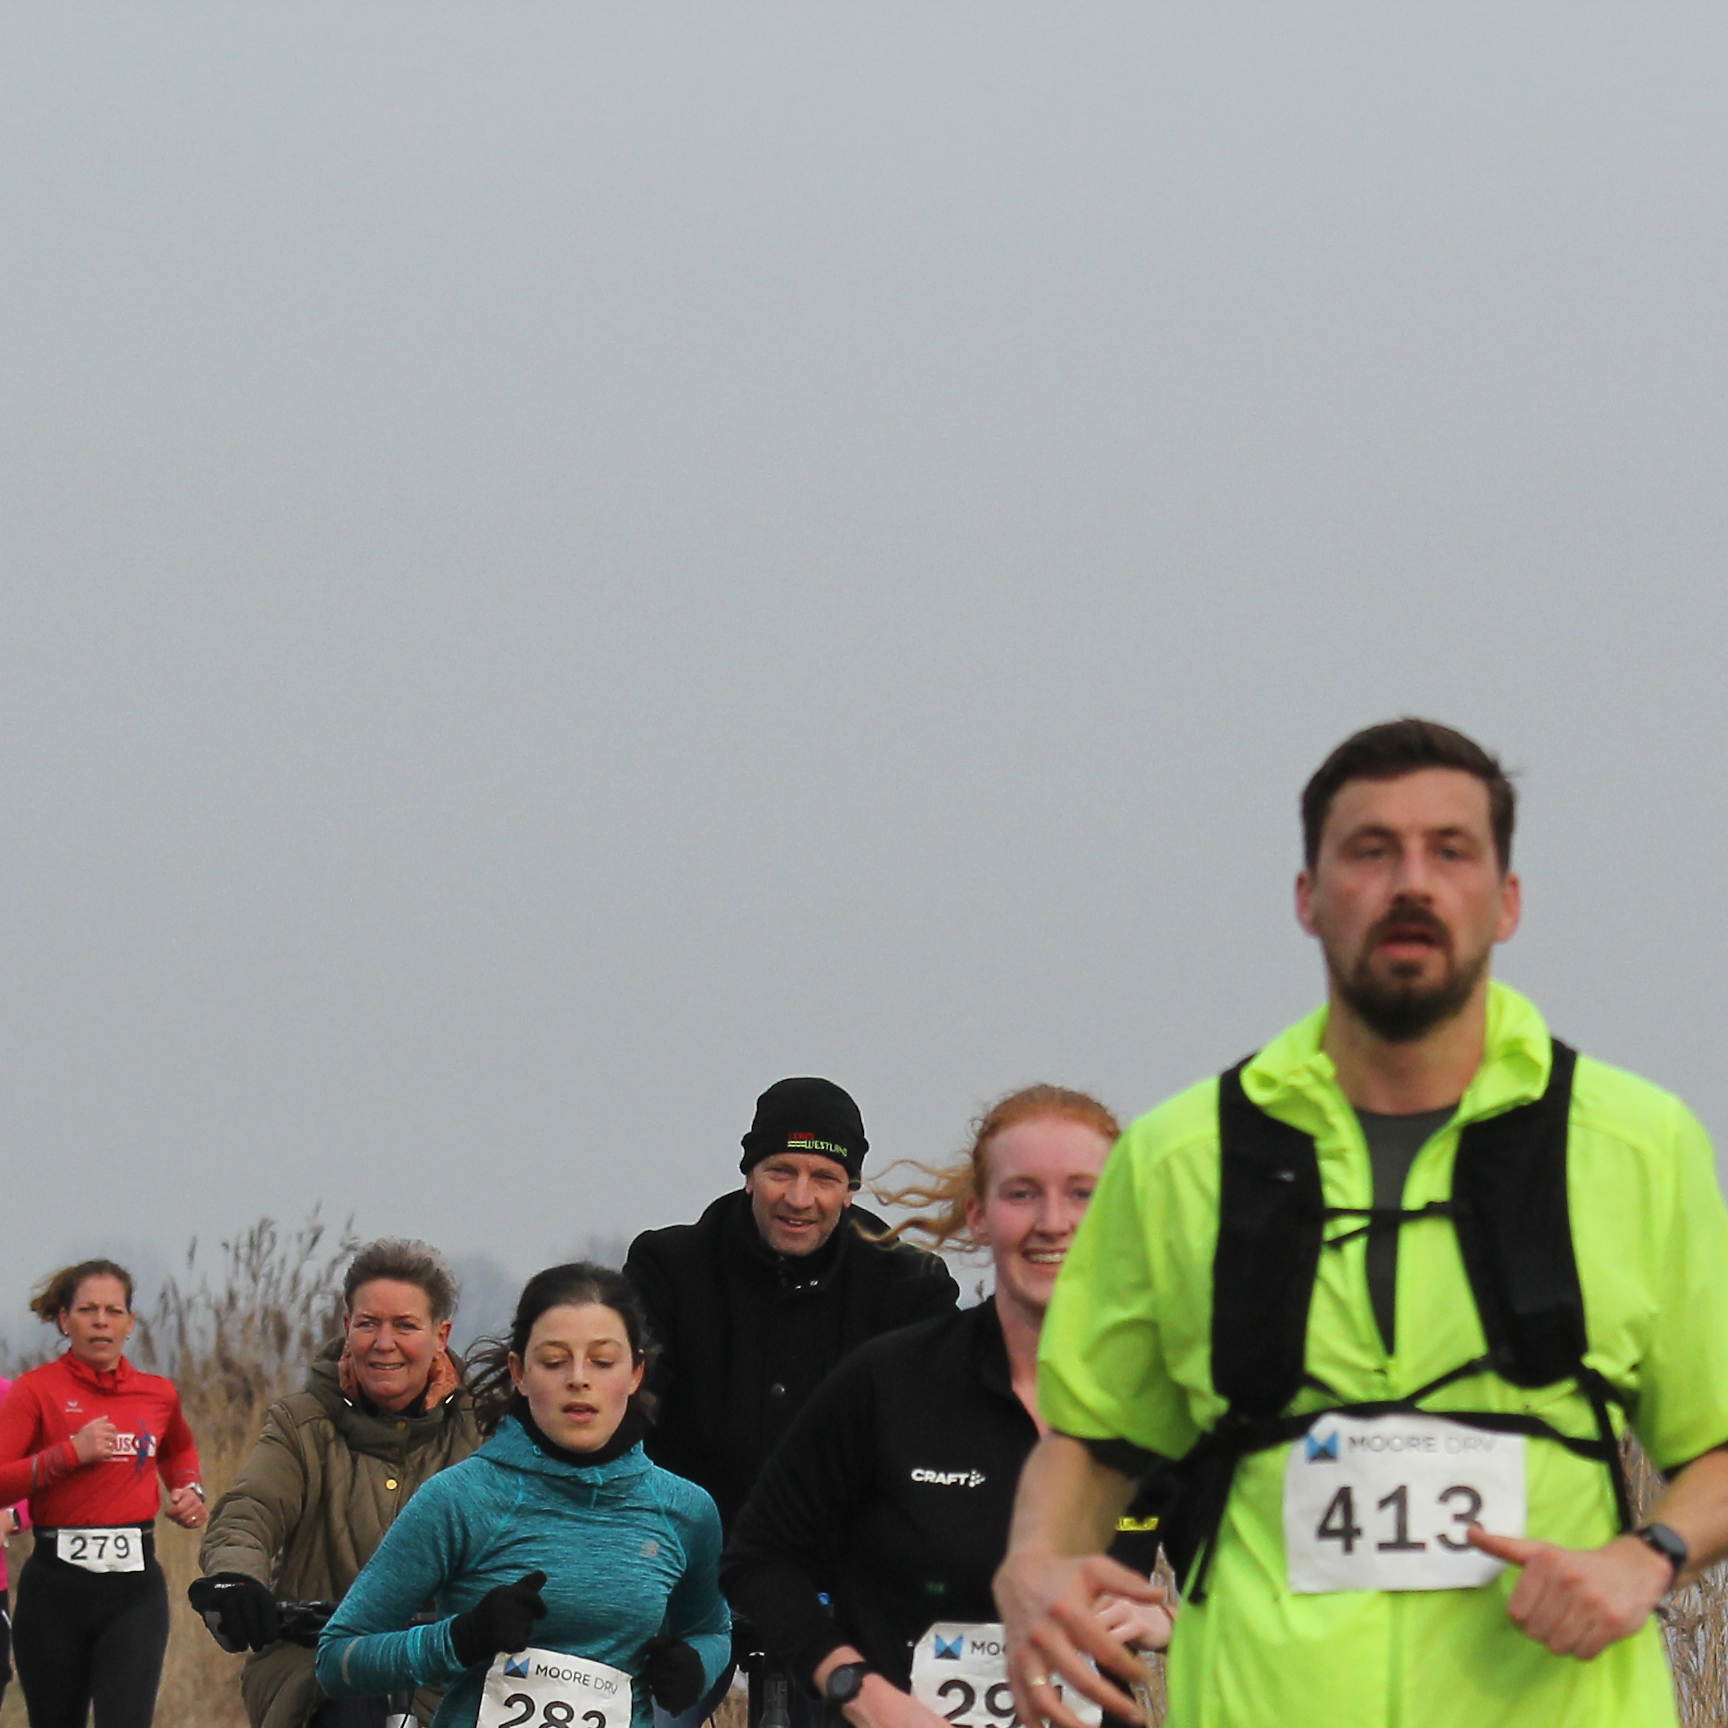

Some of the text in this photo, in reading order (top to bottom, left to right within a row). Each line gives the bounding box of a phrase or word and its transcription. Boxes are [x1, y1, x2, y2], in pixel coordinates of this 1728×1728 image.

[1349, 1435, 1437, 1452] MOORE
[911, 1469, 970, 1486] CRAFT
[1317, 1484, 1483, 1554] 413
[70, 1535, 130, 1561] 279
[535, 1663, 618, 1695] MOORE DRV
